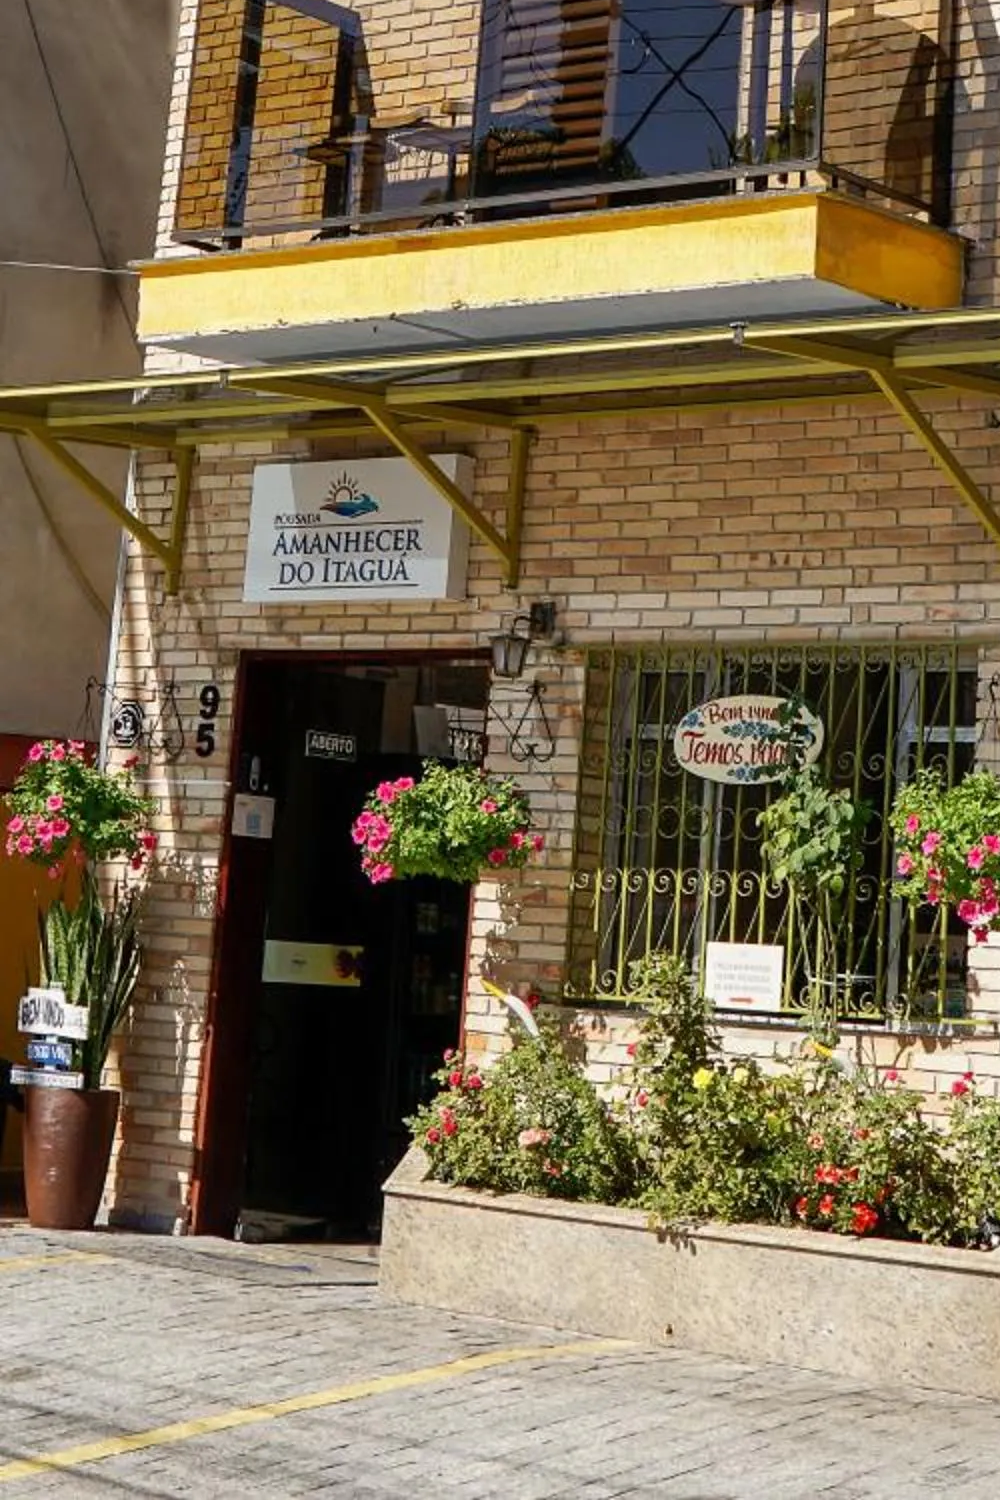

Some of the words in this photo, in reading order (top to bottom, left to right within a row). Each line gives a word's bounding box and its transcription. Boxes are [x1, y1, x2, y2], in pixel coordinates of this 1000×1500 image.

[272, 529, 422, 556] AMANHECER
[279, 560, 314, 585] DO
[322, 551, 410, 582] ITAGUÁ
[310, 734, 354, 754] ABERTO
[680, 730, 743, 766] Temos
